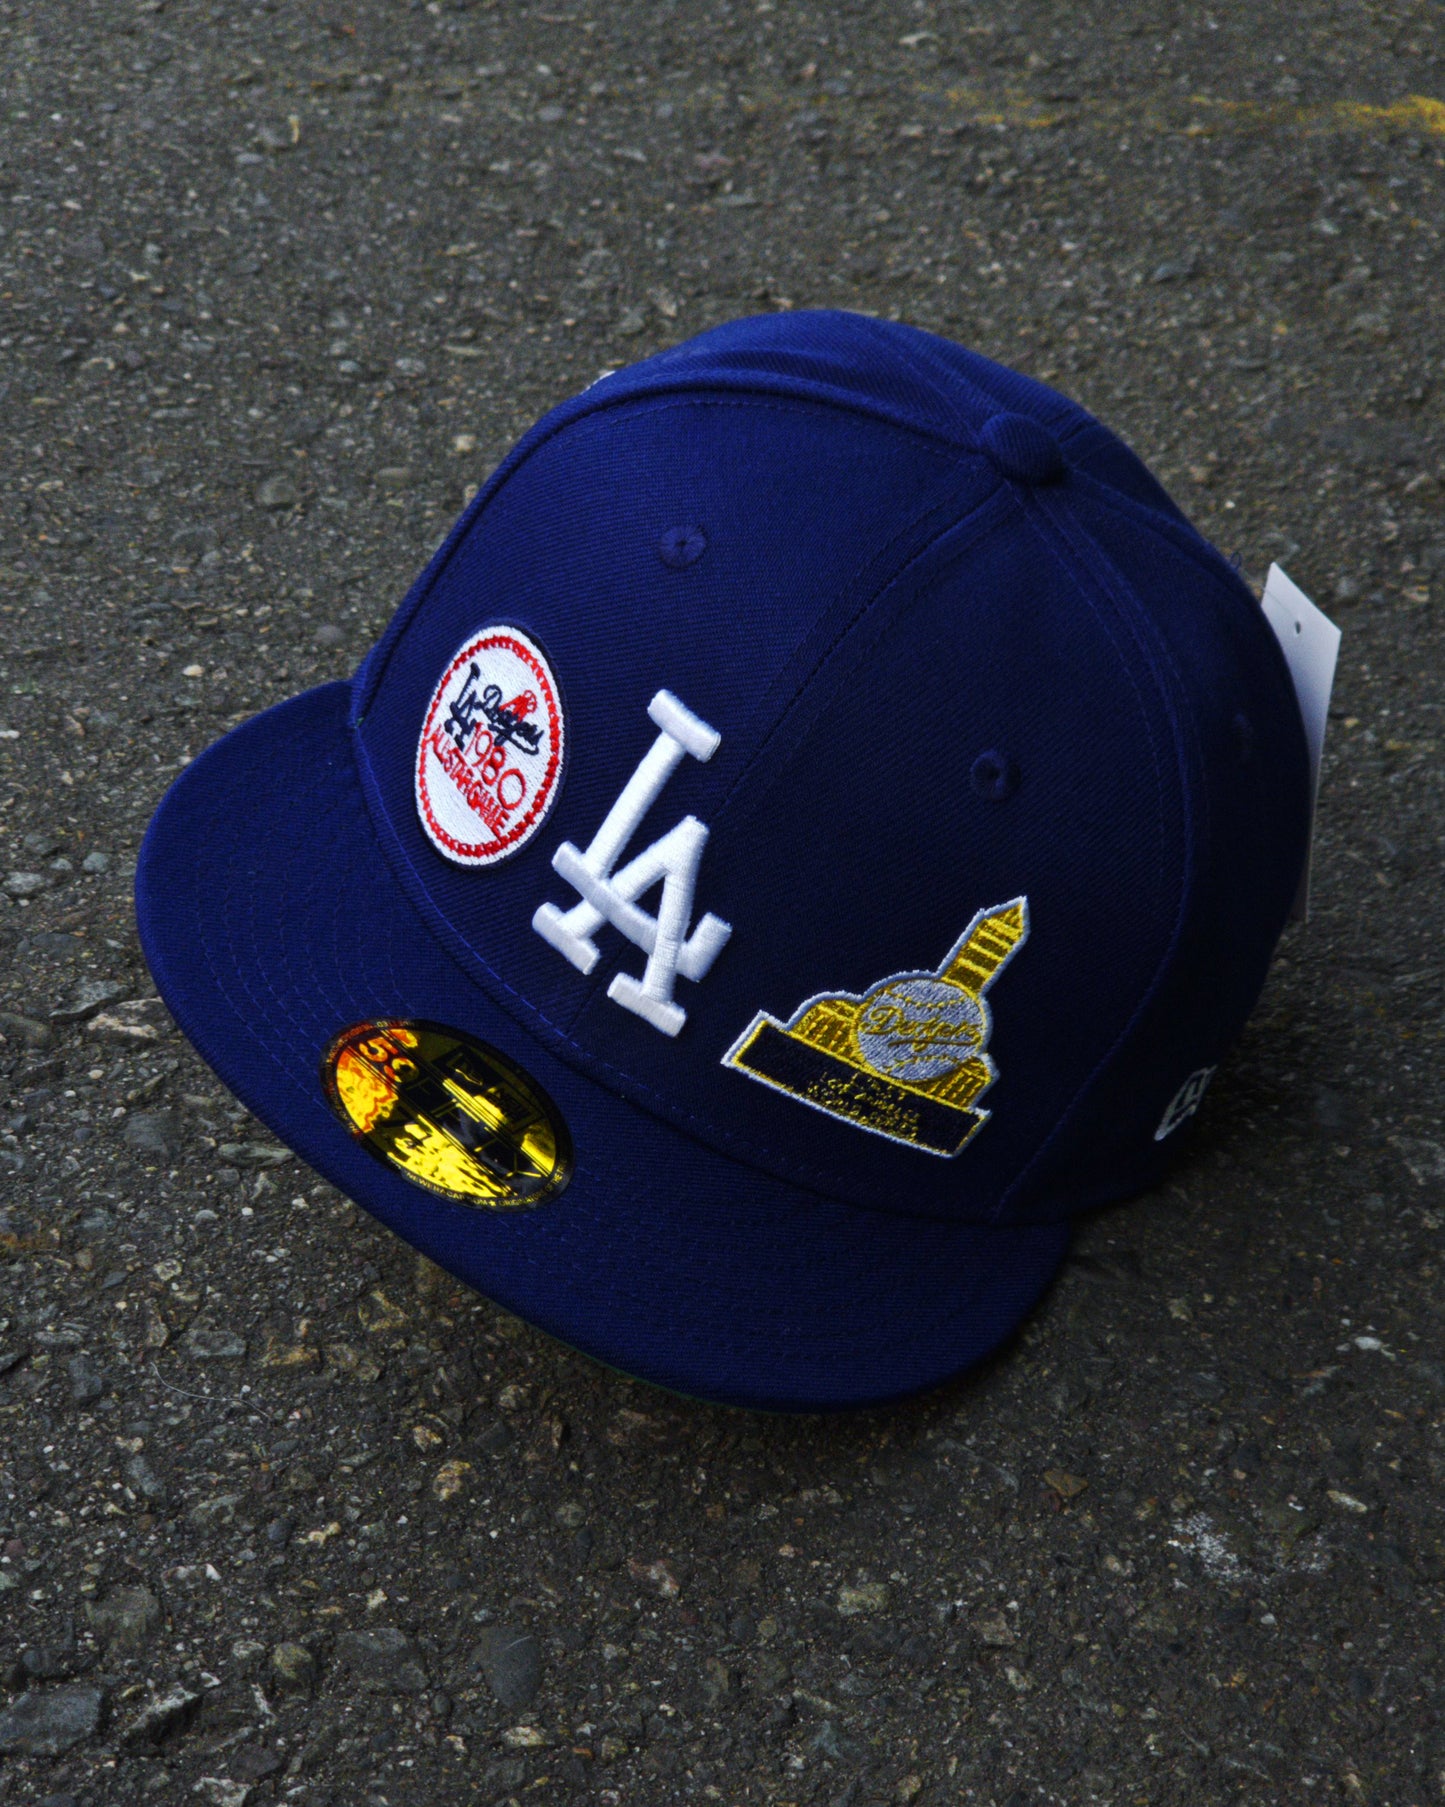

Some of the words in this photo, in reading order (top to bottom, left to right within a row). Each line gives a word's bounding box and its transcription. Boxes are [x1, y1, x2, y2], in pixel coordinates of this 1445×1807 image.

[464, 721, 527, 811] 1980
[532, 689, 732, 1037] LA
[859, 1005, 982, 1052] Dodgers
